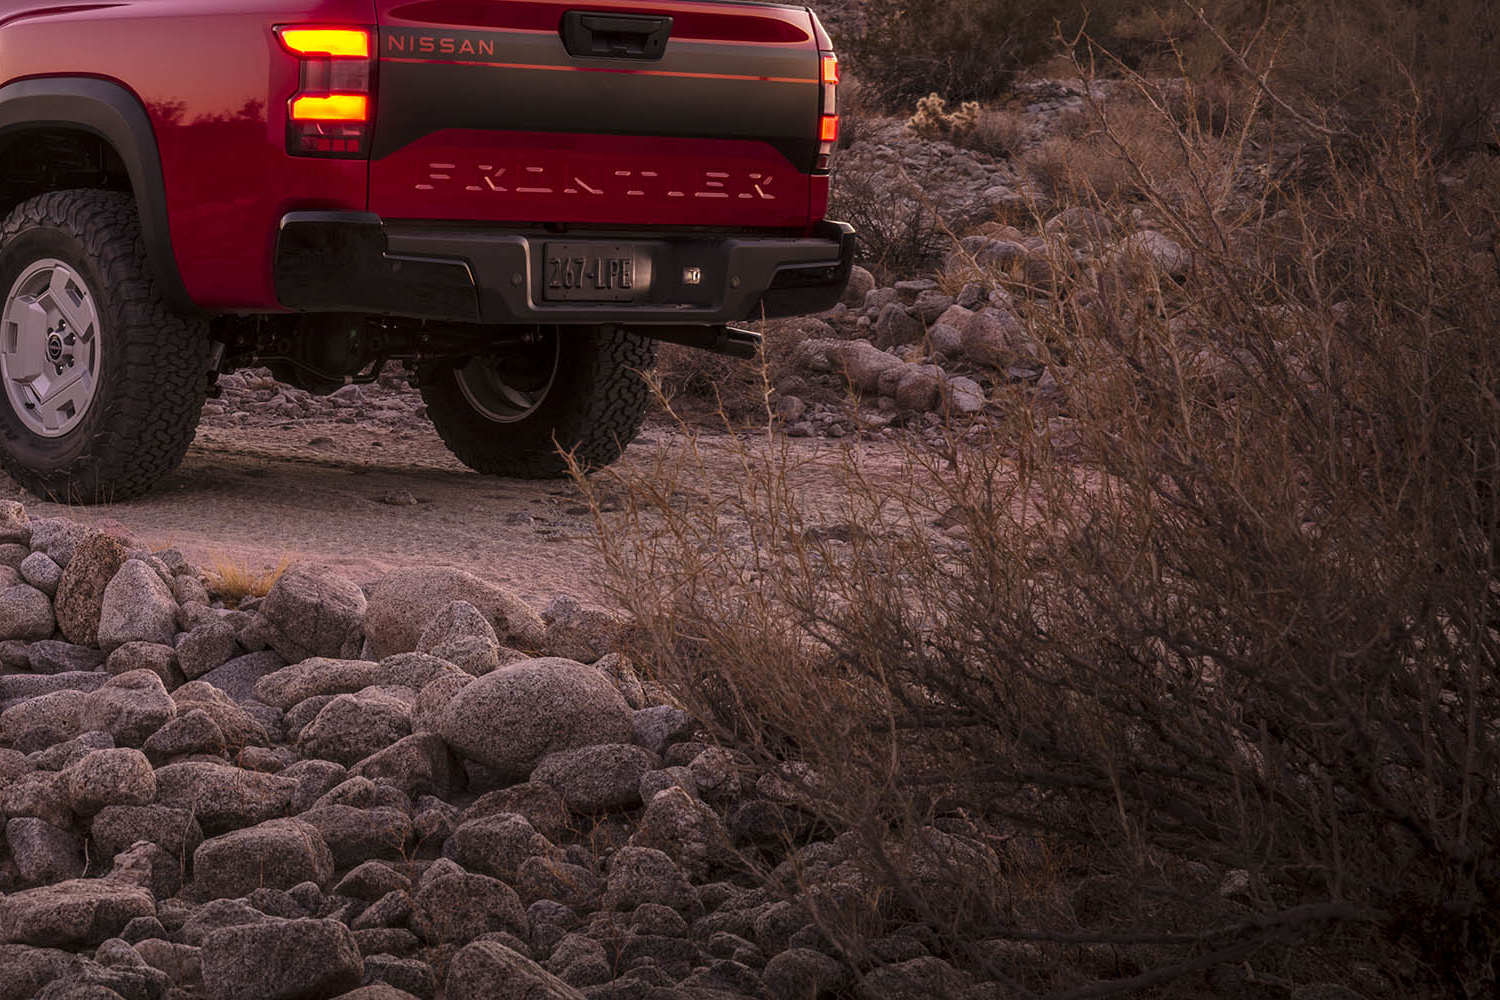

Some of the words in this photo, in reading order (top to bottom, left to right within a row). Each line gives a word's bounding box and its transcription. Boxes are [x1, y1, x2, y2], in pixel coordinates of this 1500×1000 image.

[387, 34, 494, 56] NISSAN
[414, 162, 776, 200] FRONTIER
[548, 256, 632, 290] 267-LPE
